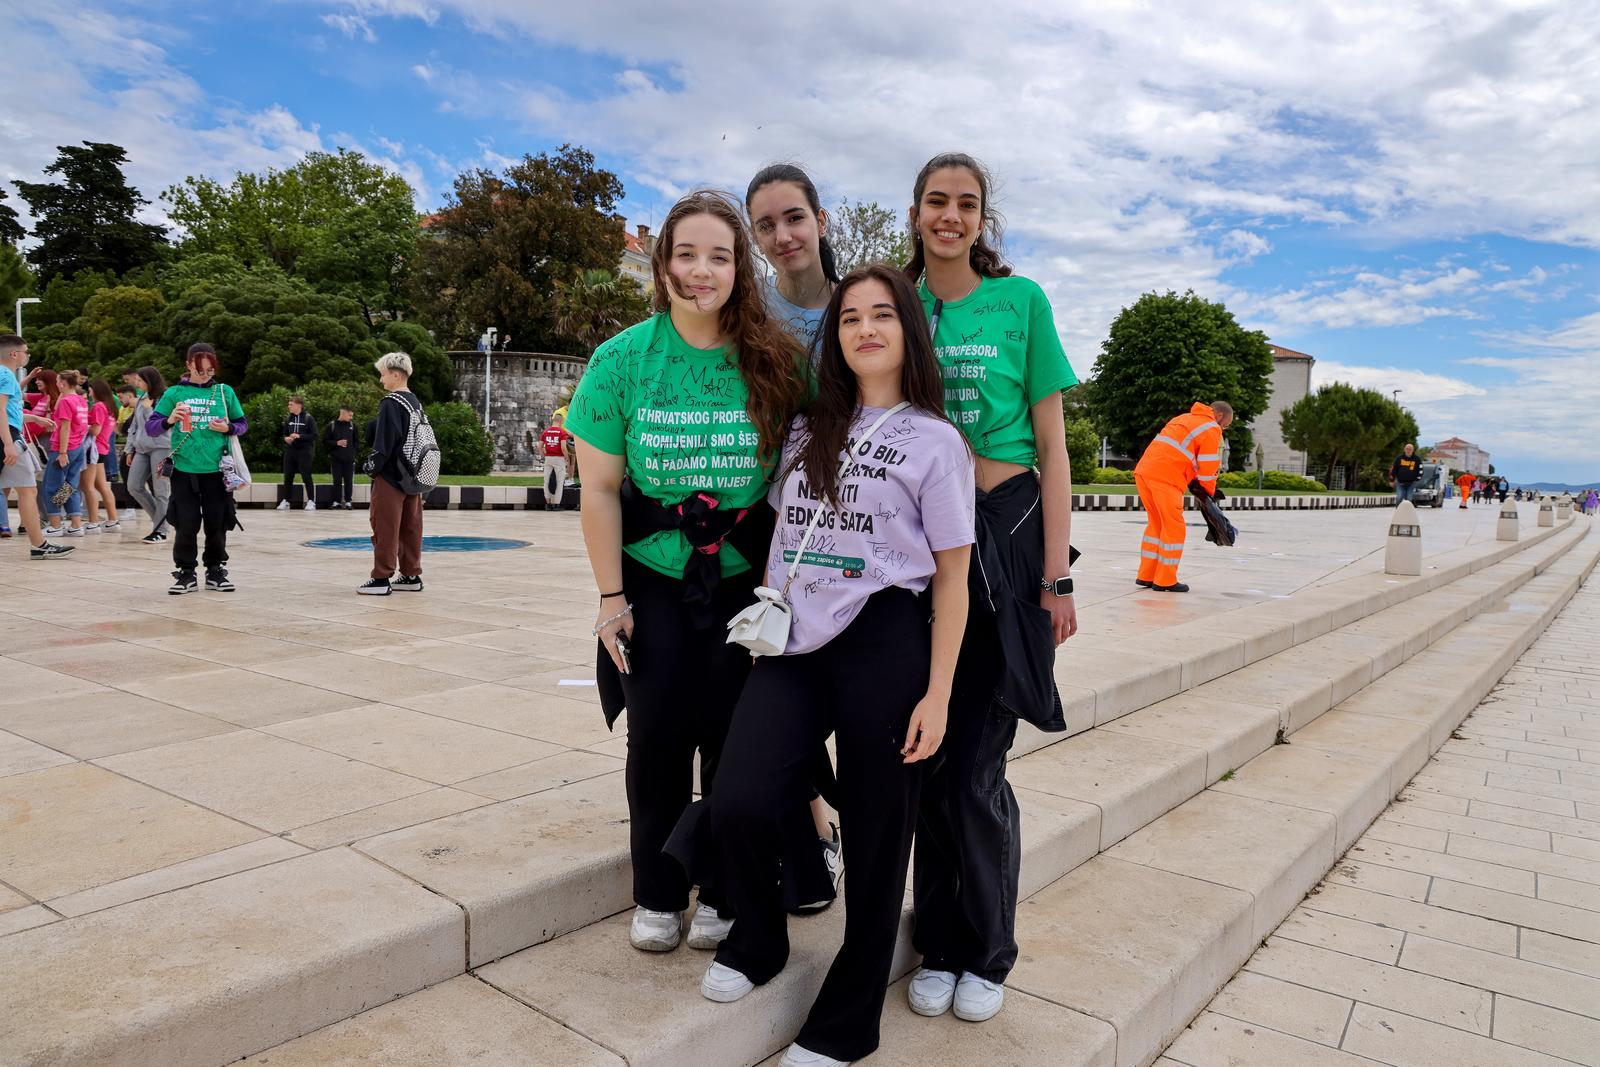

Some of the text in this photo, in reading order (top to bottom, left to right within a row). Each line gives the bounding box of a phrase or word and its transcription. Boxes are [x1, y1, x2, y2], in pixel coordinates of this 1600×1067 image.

[1004, 329, 1026, 342] TEA
[945, 344, 998, 358] PROFESORA
[960, 363, 987, 382] ŠEST,
[945, 387, 979, 401] MATURU
[637, 408, 646, 422] IZ
[647, 409, 710, 425] HRVATSKOG
[640, 432, 707, 449] PROMIJENILI
[711, 433, 735, 447] SMO
[645, 456, 758, 471] DA PADAMO MATURU
[873, 444, 907, 466] BILI
[646, 475, 753, 488] TO JE STARA VIJEST
[842, 484, 859, 503] ITI
[840, 510, 874, 535] SATA
